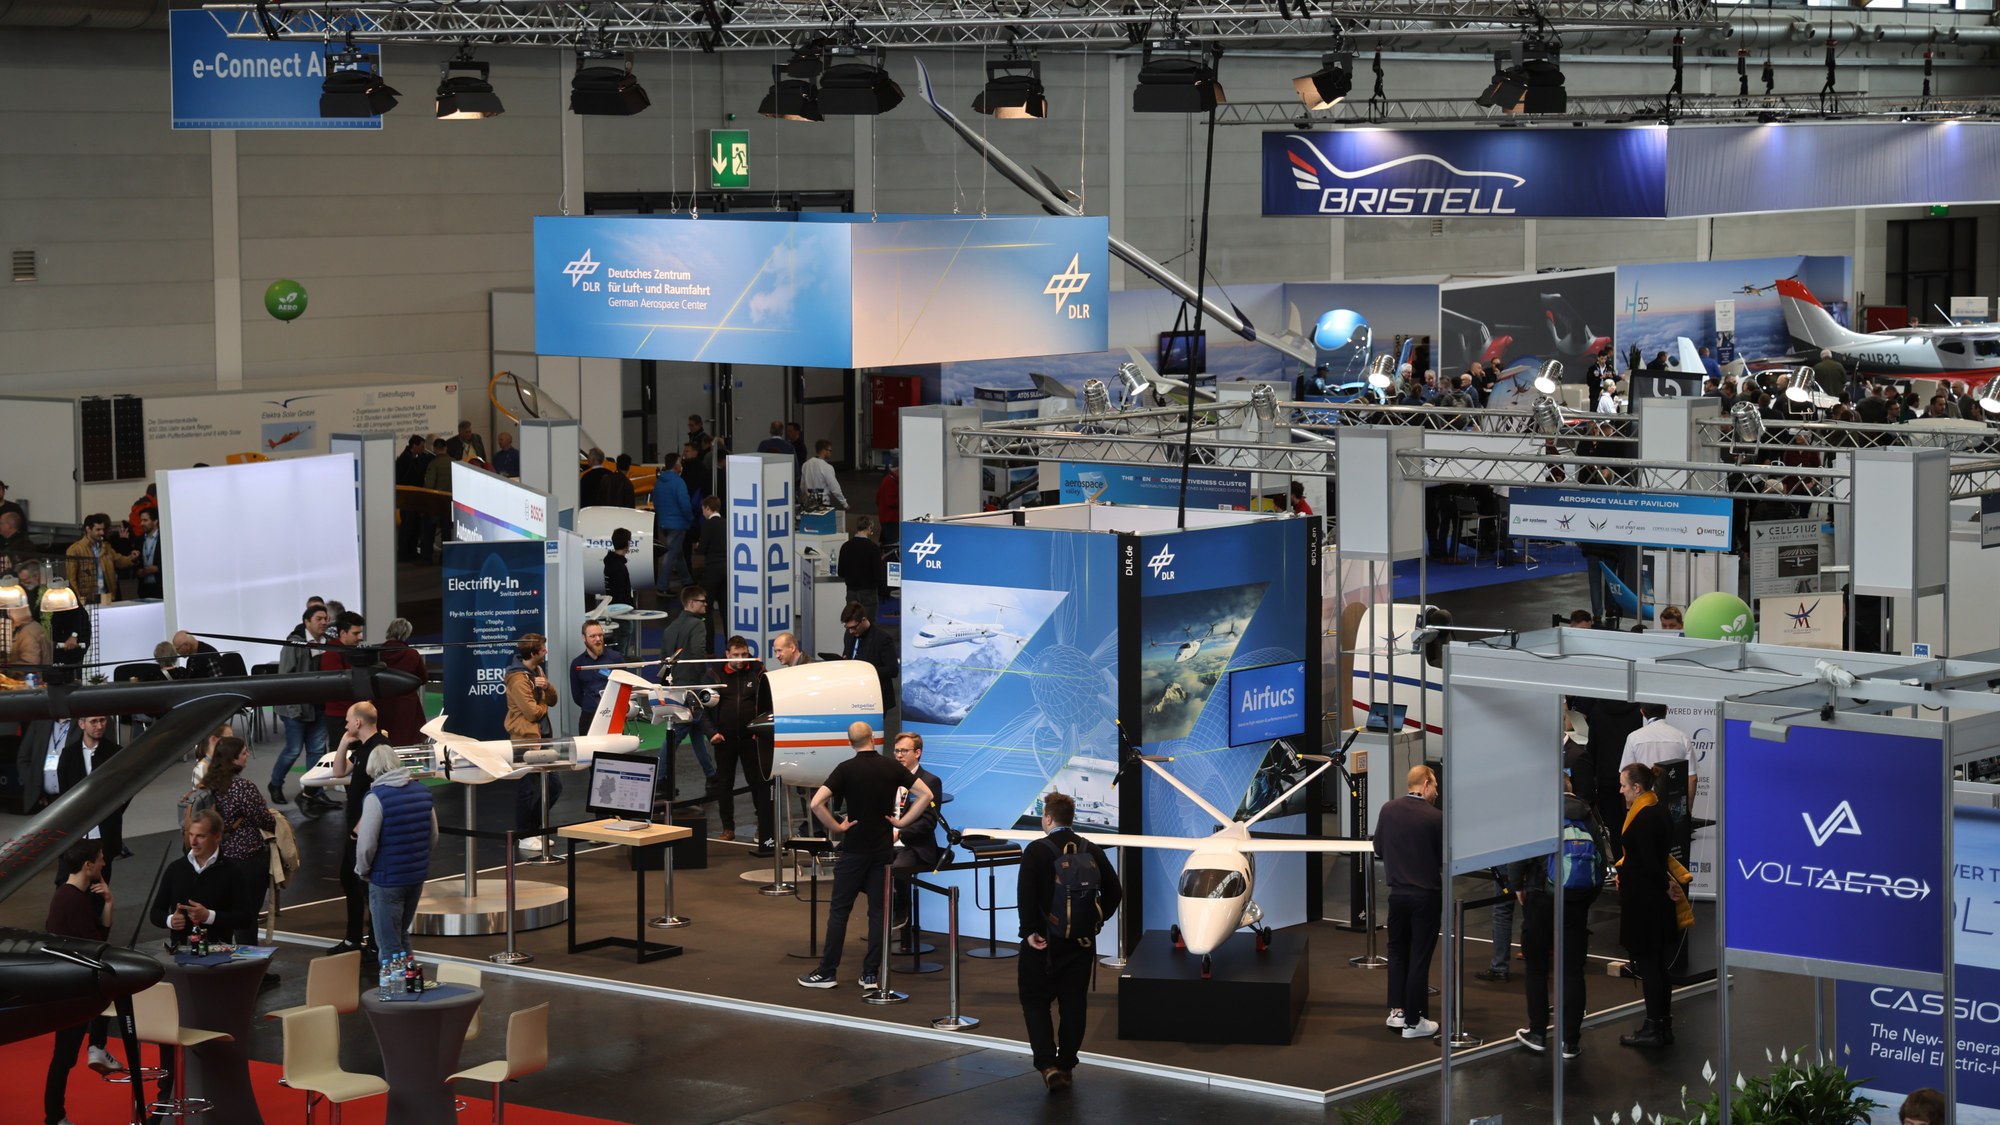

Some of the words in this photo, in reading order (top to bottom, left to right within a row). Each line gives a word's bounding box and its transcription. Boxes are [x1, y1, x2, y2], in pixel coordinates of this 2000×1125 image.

[192, 52, 301, 78] e-Connect
[1318, 188, 1516, 213] BRISTELL
[608, 268, 652, 278] Deutsches
[653, 269, 691, 280] Zentrum
[582, 281, 600, 292] DLR
[608, 282, 620, 293] für
[622, 282, 643, 293] Luft-
[645, 283, 662, 294] und
[664, 284, 711, 295] Raumfahrt
[608, 297, 639, 307] German
[640, 298, 679, 310] Aerospace
[681, 299, 707, 310] Center
[1068, 303, 1090, 319] DLR
[261, 411, 281, 419] Elektra
[282, 410, 296, 418] Solar
[1064, 479, 1104, 489] aerospace
[1559, 495, 1607, 504] AEROSPACE
[1608, 498, 1639, 506] VALLEY
[1641, 500, 1679, 508] PAVILION
[531, 504, 544, 523] BOSCH
[1768, 524, 1817, 536] CELLSIUS
[925, 559, 942, 570] DLR
[1125, 545, 1133, 576] DLR.de
[1161, 570, 1175, 581] DLR
[448, 576, 519, 592] Electrifly-In
[449, 611, 465, 619] Fly-In
[474, 609, 494, 617] electric
[495, 608, 519, 616] powered
[1241, 685, 1295, 713] Airfucs
[1738, 858, 1921, 899] VOLTAERO
[1870, 1023, 1898, 1040] The
[1903, 1028, 2000, 1056] New-enera
[1870, 1043, 1925, 1064] Parallel
[1930, 1051, 2000, 1075] Elctric-H
